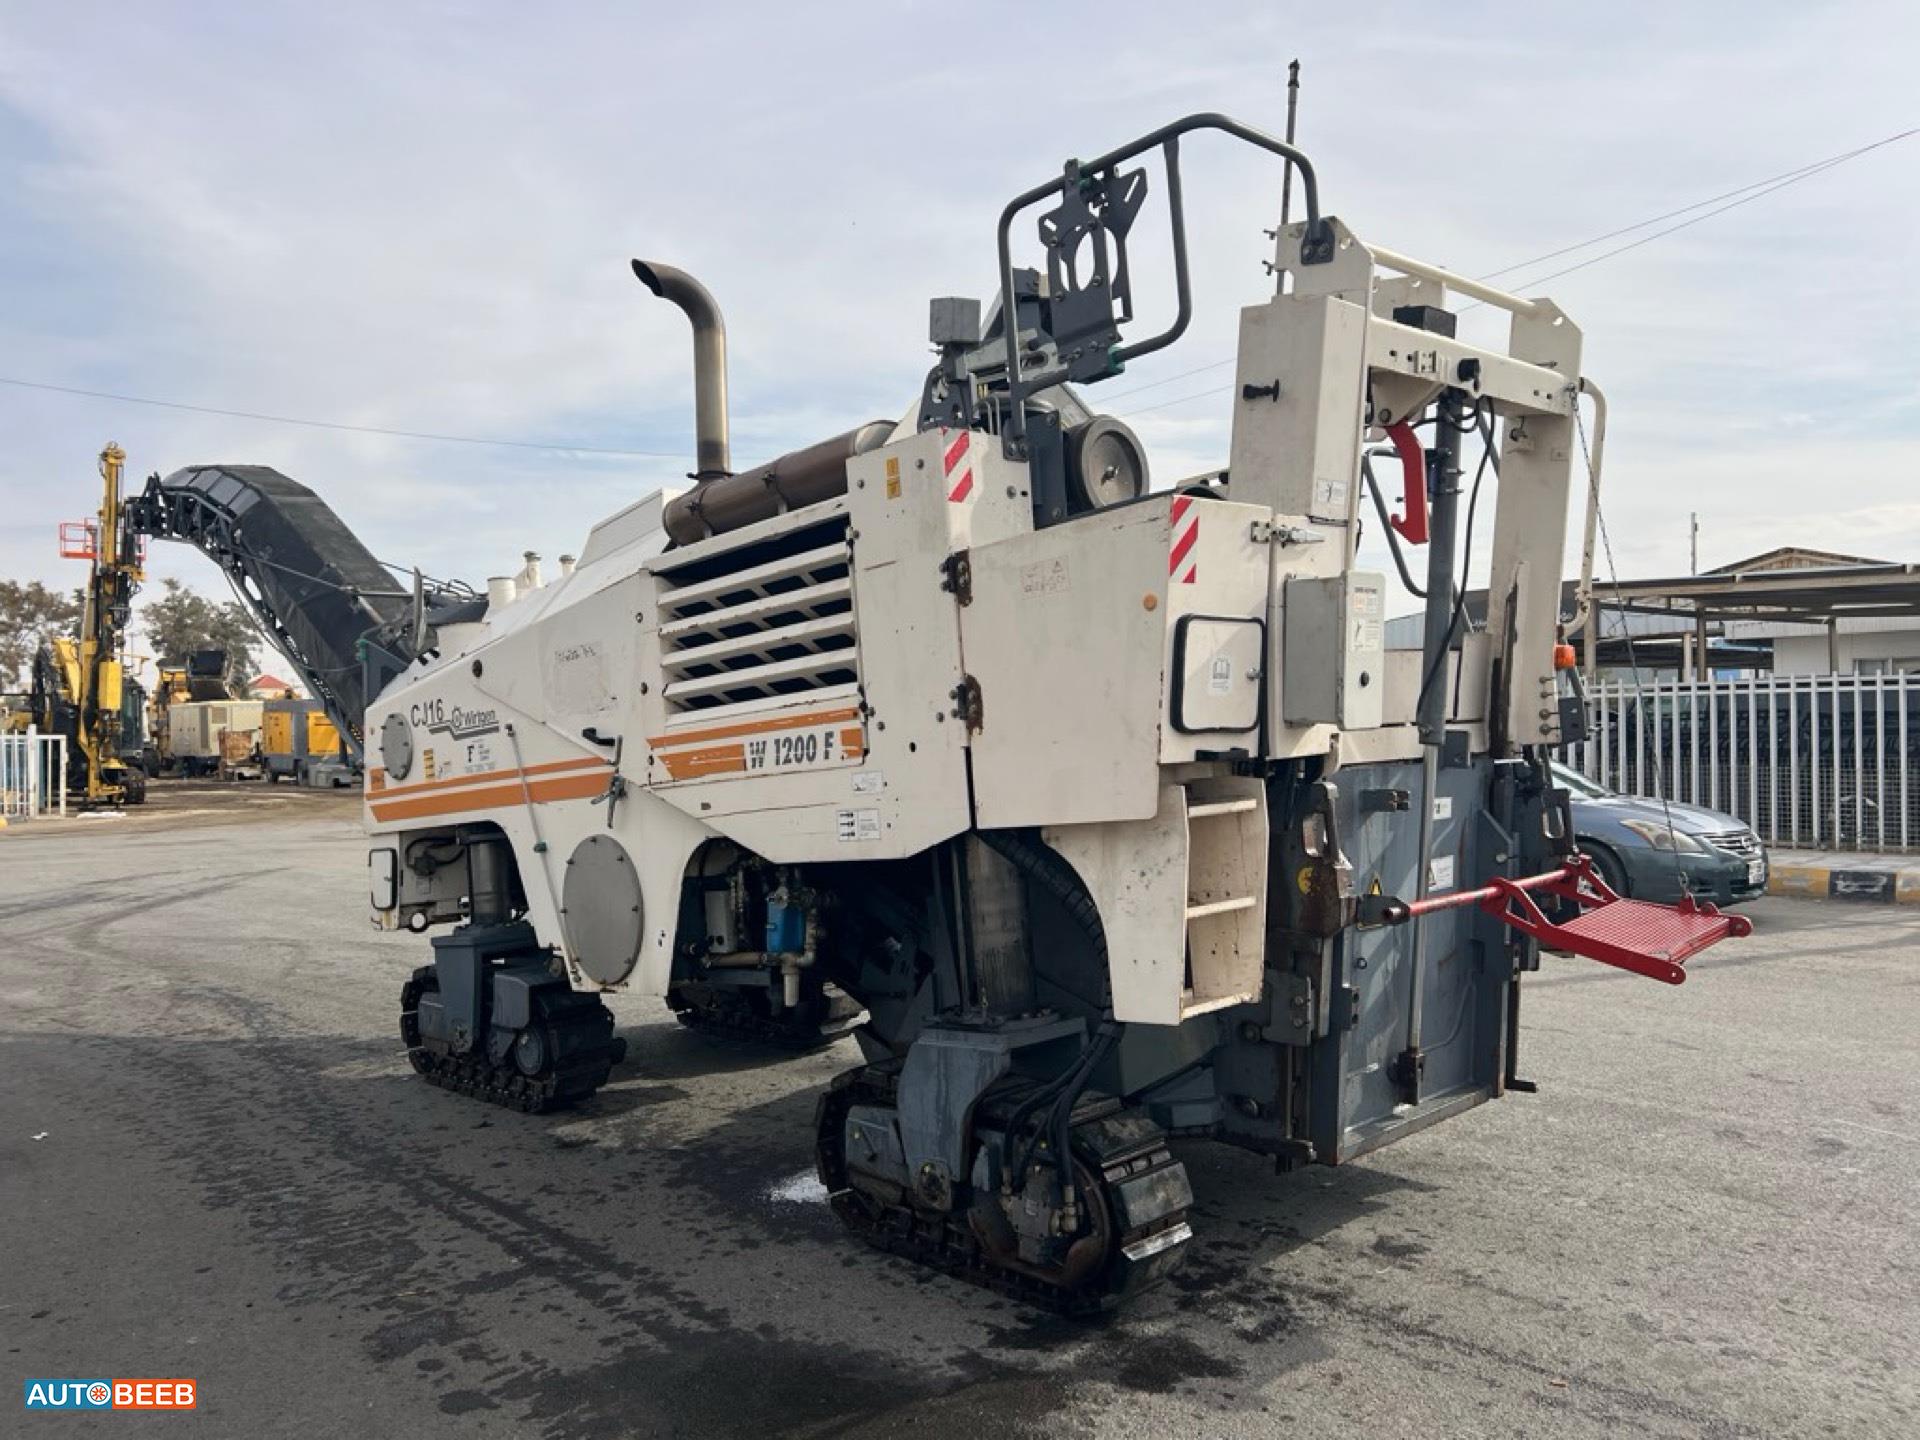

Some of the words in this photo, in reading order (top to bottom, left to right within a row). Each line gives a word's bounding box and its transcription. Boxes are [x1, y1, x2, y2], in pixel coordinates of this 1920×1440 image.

[411, 698, 443, 727] CJ16
[749, 740, 767, 769] W
[774, 734, 817, 766] 1200
[824, 731, 834, 760] F
